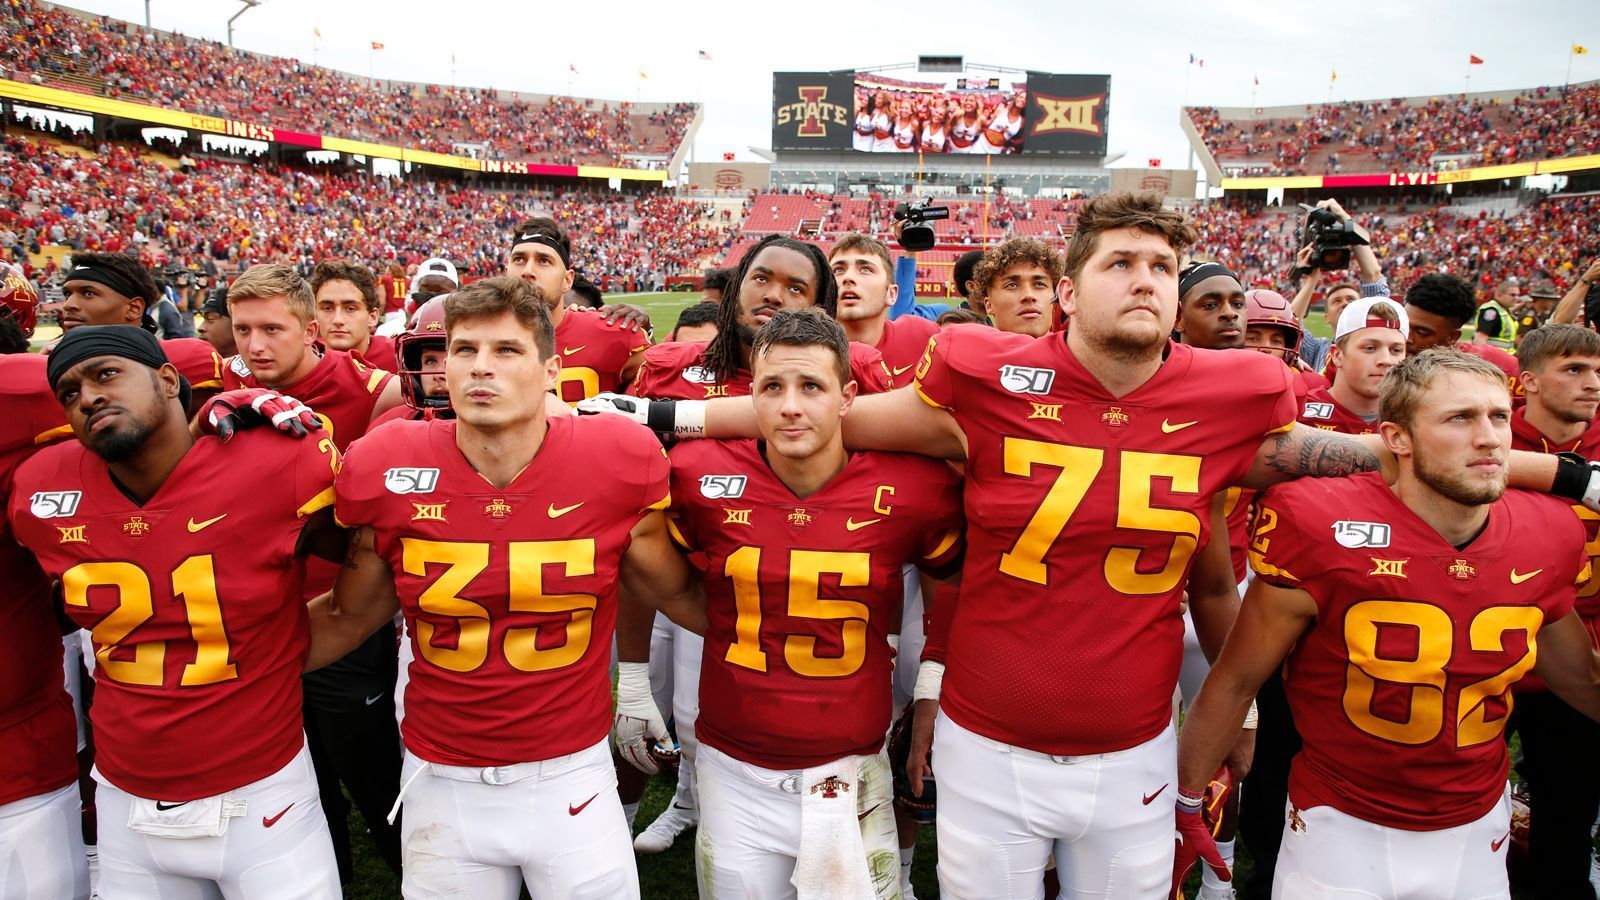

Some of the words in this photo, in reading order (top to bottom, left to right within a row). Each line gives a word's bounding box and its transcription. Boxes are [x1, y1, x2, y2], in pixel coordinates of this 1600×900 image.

[777, 102, 848, 126] STATE
[1035, 96, 1101, 134] XII
[393, 280, 407, 299] 11
[1001, 366, 1054, 394] 150
[1027, 402, 1064, 422] XII
[1102, 412, 1129, 422] STATE
[1303, 403, 1335, 419] 50
[674, 425, 704, 434] AMILY
[386, 468, 440, 494] 150
[700, 475, 748, 498] 150
[30, 490, 82, 518] 150
[485, 503, 512, 513] STATE
[873, 485, 895, 516] C
[411, 503, 447, 521] XII
[723, 507, 753, 525] XII
[787, 512, 812, 522] STATE
[999, 436, 1203, 595] 75
[57, 524, 87, 544] XII
[123, 521, 149, 532] STATE
[1333, 520, 1391, 549] 150
[1369, 557, 1409, 579] XII
[1449, 563, 1476, 575] STATE
[400, 537, 598, 673] 35
[724, 545, 872, 678] 15
[62, 553, 239, 687] 21
[1342, 599, 1545, 749] 82
